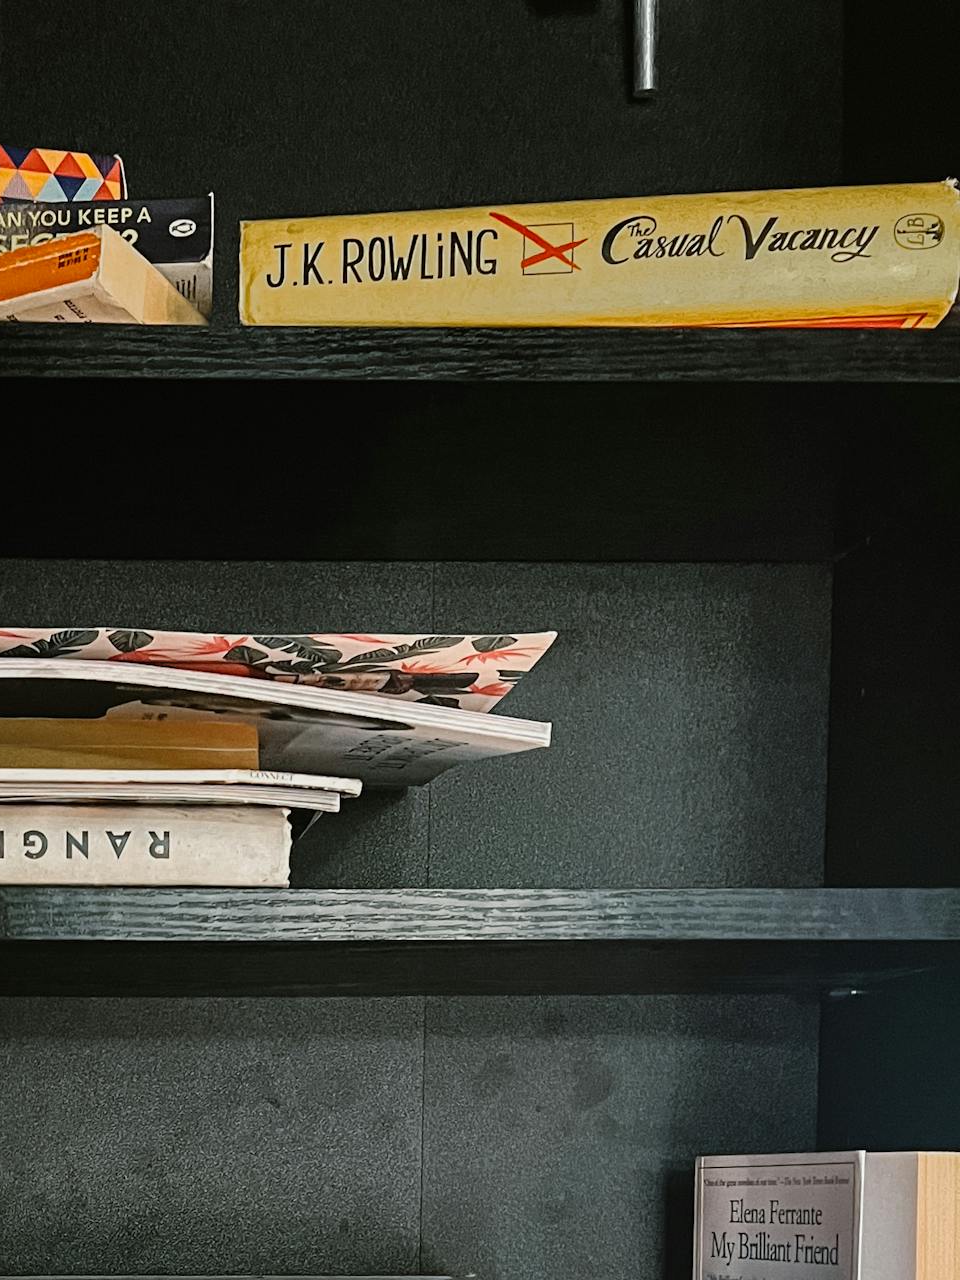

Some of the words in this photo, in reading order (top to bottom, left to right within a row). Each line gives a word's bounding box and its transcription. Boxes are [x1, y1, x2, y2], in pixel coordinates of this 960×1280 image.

[30, 209, 70, 226] YOU
[78, 208, 133, 224] KEEP
[136, 206, 151, 223] A
[627, 223, 655, 239] The
[601, 215, 723, 265] Casual
[729, 213, 879, 262] Vacancy
[730, 1199, 765, 1225] Elena
[769, 1200, 823, 1225] Ferrante
[711, 1231, 736, 1266] My
[738, 1232, 792, 1263] Brilliant
[794, 1233, 840, 1266] Friend
